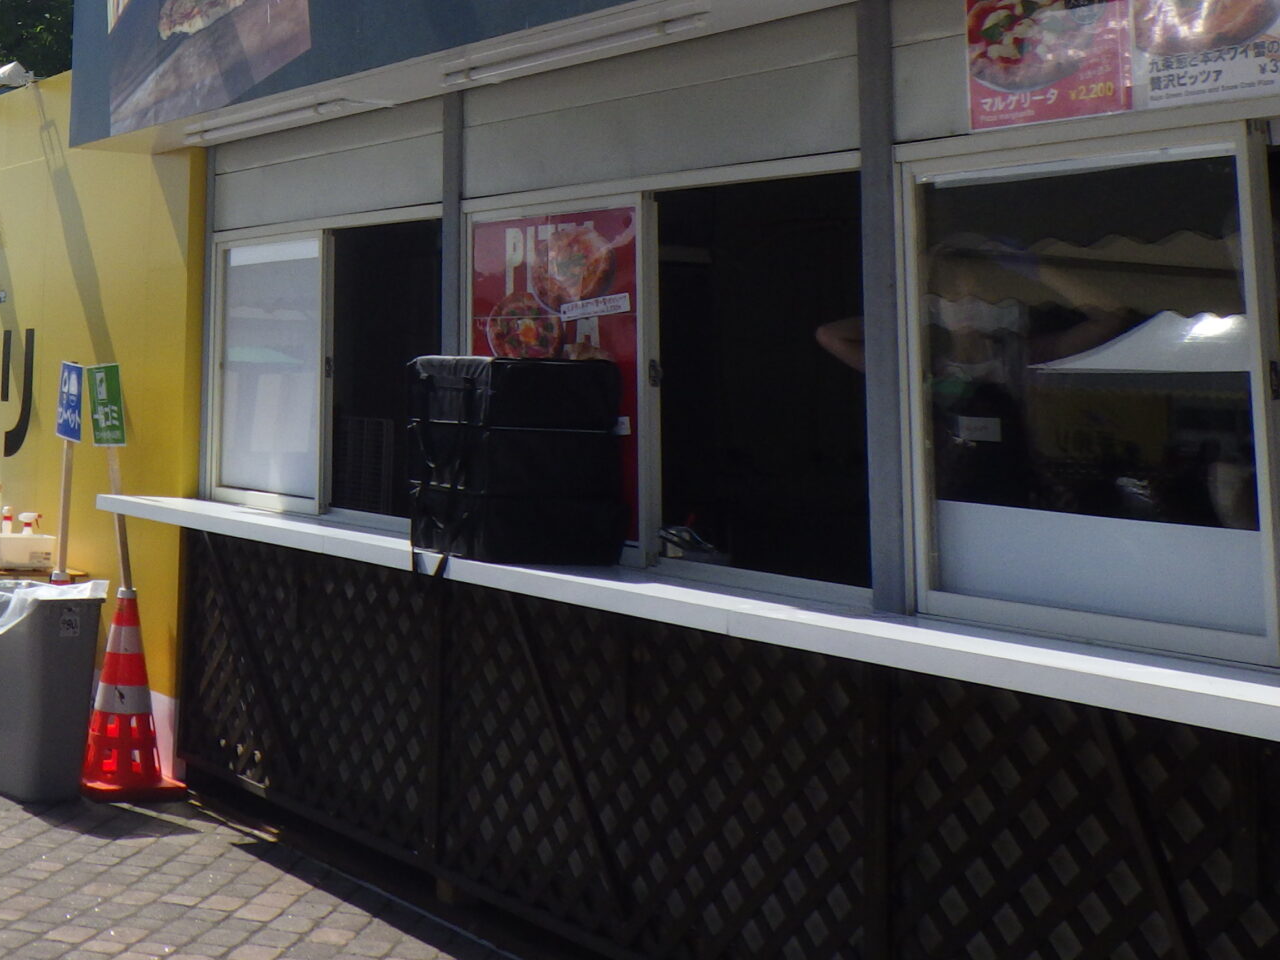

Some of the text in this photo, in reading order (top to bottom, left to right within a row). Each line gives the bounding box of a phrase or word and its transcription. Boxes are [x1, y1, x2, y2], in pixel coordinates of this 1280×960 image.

[980, 88, 1058, 113] マルゲリータ
